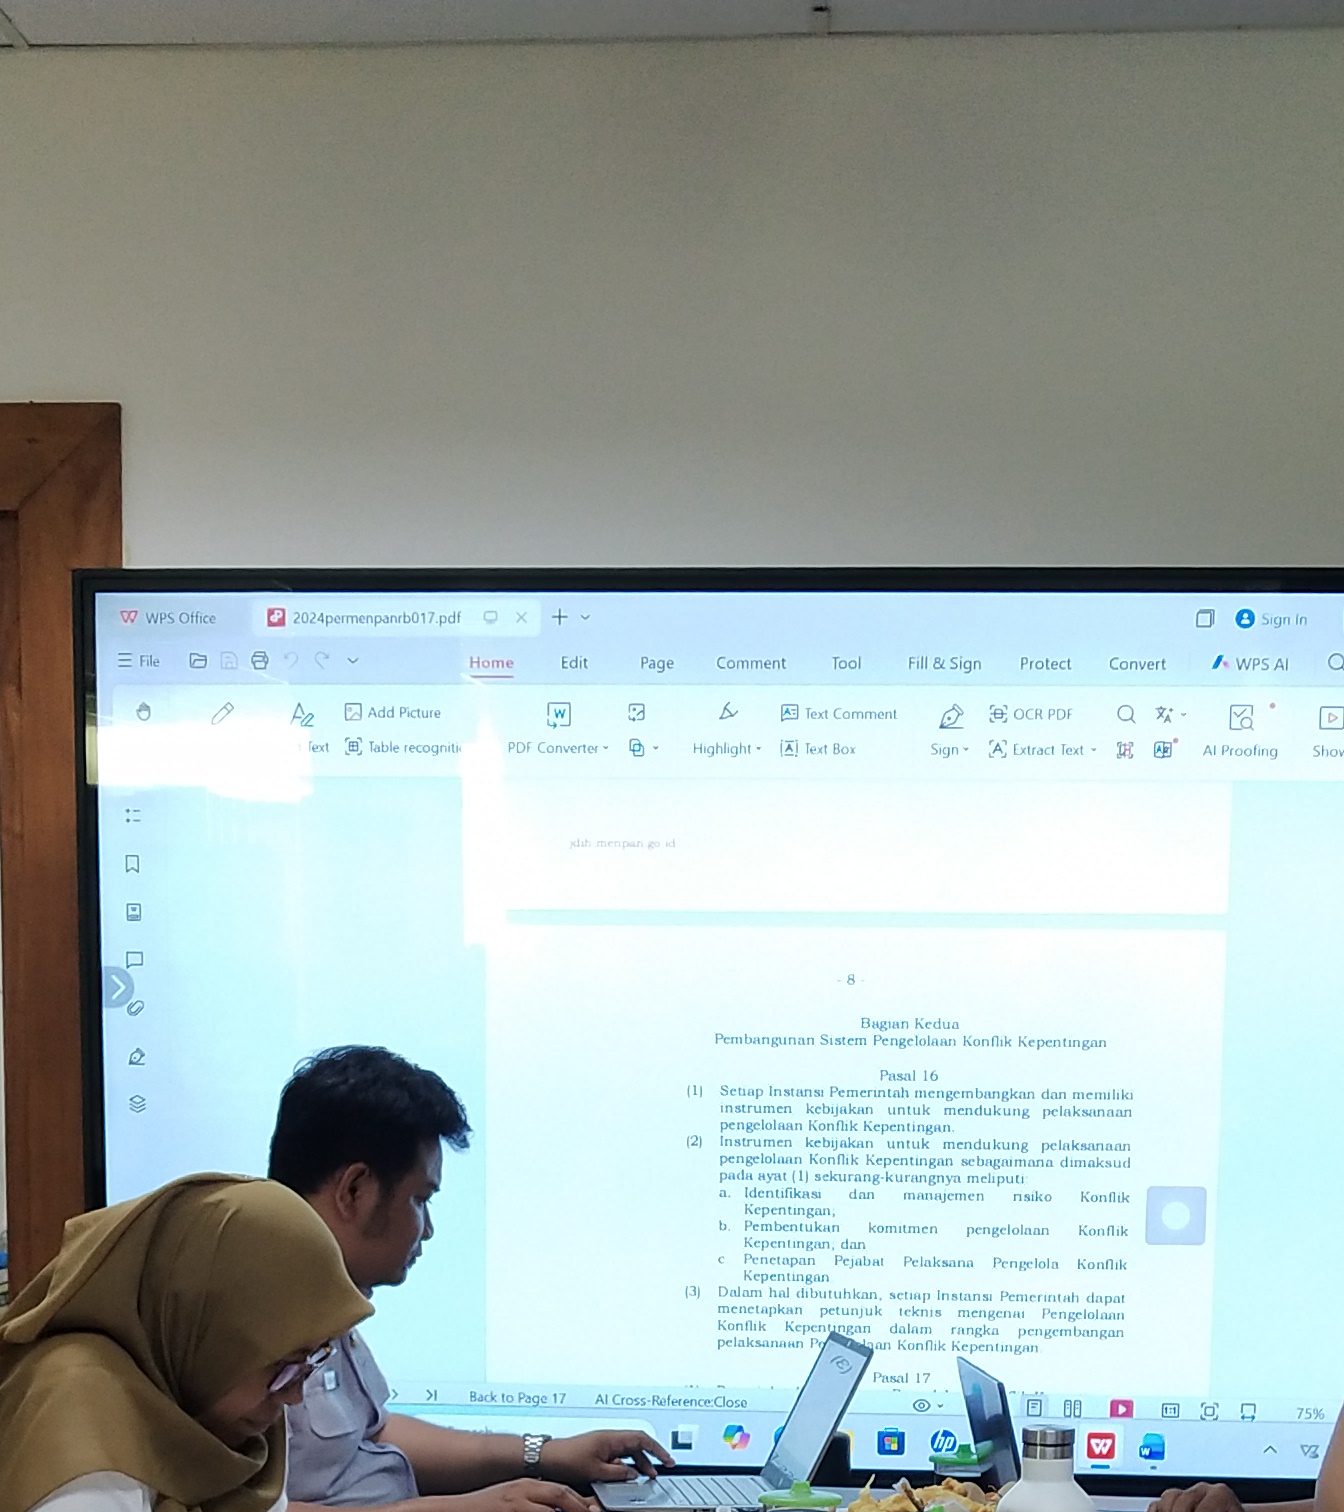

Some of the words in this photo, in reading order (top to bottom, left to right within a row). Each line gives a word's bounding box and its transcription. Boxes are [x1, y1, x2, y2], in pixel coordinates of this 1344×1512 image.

[145, 611, 174, 625] WPS
[178, 611, 216, 625] Office
[293, 610, 461, 627] 2024permenpanrb017.pdf
[1261, 613, 1290, 628] Sign
[1295, 613, 1307, 625] In
[139, 654, 159, 668] File
[469, 656, 514, 670] Home
[561, 656, 588, 670] Edit
[640, 656, 674, 673] Page
[716, 656, 786, 670] Comment
[832, 656, 861, 670] Tool
[908, 656, 928, 670] Fill
[932, 657, 946, 670] &
[949, 656, 982, 673] Sign
[1020, 656, 1071, 670] Protect
[1109, 657, 1166, 670] Convert
[1236, 657, 1269, 671] WPS
[1275, 657, 1289, 671] AI
[368, 706, 394, 718] Add
[400, 706, 441, 718] Picture
[805, 708, 828, 720] Text
[833, 708, 898, 720] Comment
[1013, 708, 1044, 721] OCR
[1047, 708, 1073, 721] PDF
[369, 742, 399, 753] Table
[405, 742, 461, 756] recogniti
[507, 742, 534, 754] PDF
[538, 742, 598, 754] Converter
[693, 743, 751, 757] Highlight
[805, 743, 828, 755] Text
[833, 743, 856, 755] Box
[930, 743, 959, 758] Sign
[1013, 743, 1055, 756] Extract
[1060, 743, 1084, 756] Text
[1203, 745, 1216, 758] AI
[1222, 744, 1278, 759] Proofing
[861, 1018, 909, 1031] Bagian
[915, 1018, 959, 1030] Kedua
[714, 1033, 815, 1047] Pembangunan
[820, 1035, 867, 1046] Sistem
[873, 1035, 957, 1049] Pengelolaan
[963, 1036, 1012, 1048] Konflik
[1018, 1036, 1106, 1050] Kepentingan
[880, 1070, 916, 1082] Pasal
[923, 1070, 938, 1082] 16
[687, 1085, 703, 1098] (1)
[719, 1085, 763, 1099] Setiap
[769, 1086, 824, 1097] Instansi
[830, 1087, 909, 1099] Pemerintah
[915, 1088, 1035, 1102] mengembangkan
[1041, 1089, 1066, 1100] dan
[1072, 1089, 1134, 1100] memiliki
[686, 1135, 702, 1149] (2)
[720, 1136, 792, 1147] Instrumen
[806, 1137, 873, 1151] kebijakan
[887, 1139, 930, 1149] untuk
[943, 1139, 1029, 1153] mendukung
[1041, 1140, 1131, 1153] pelaksanaan
[719, 1170, 753, 1182] pada
[757, 1172, 787, 1183] ayat
[792, 1170, 809, 1183] (1)
[814, 1170, 961, 1186] sekurang-kurangnya
[719, 1189, 731, 1198] a.
[745, 1187, 822, 1199] Identifikasi
[849, 1189, 875, 1200] dan
[903, 1192, 984, 1203] manajemen
[1013, 1191, 1052, 1202] risiko
[1080, 1191, 1130, 1203] Konflik
[744, 1204, 835, 1218] Kepentingan;
[685, 1285, 700, 1299] (3)
[718, 1286, 762, 1298] Dalam
[769, 1287, 790, 1299] hal
[796, 1288, 882, 1301] dibutuhkan,
[889, 1290, 930, 1304] setiap
[936, 1290, 993, 1301] Instansi
[1000, 1291, 1079, 1303] Pemerintah
[1086, 1293, 1125, 1305] dapat
[873, 1372, 908, 1383] Pasal
[916, 1373, 930, 1383] 17
[470, 1391, 497, 1402] Back
[502, 1392, 514, 1402] to
[518, 1392, 547, 1405] Page
[553, 1392, 566, 1404] 17
[595, 1394, 608, 1405] AI
[612, 1394, 747, 1408] Cross-Reference:Close
[1297, 1407, 1325, 1421] 75%
[934, 1433, 954, 1451] hp
